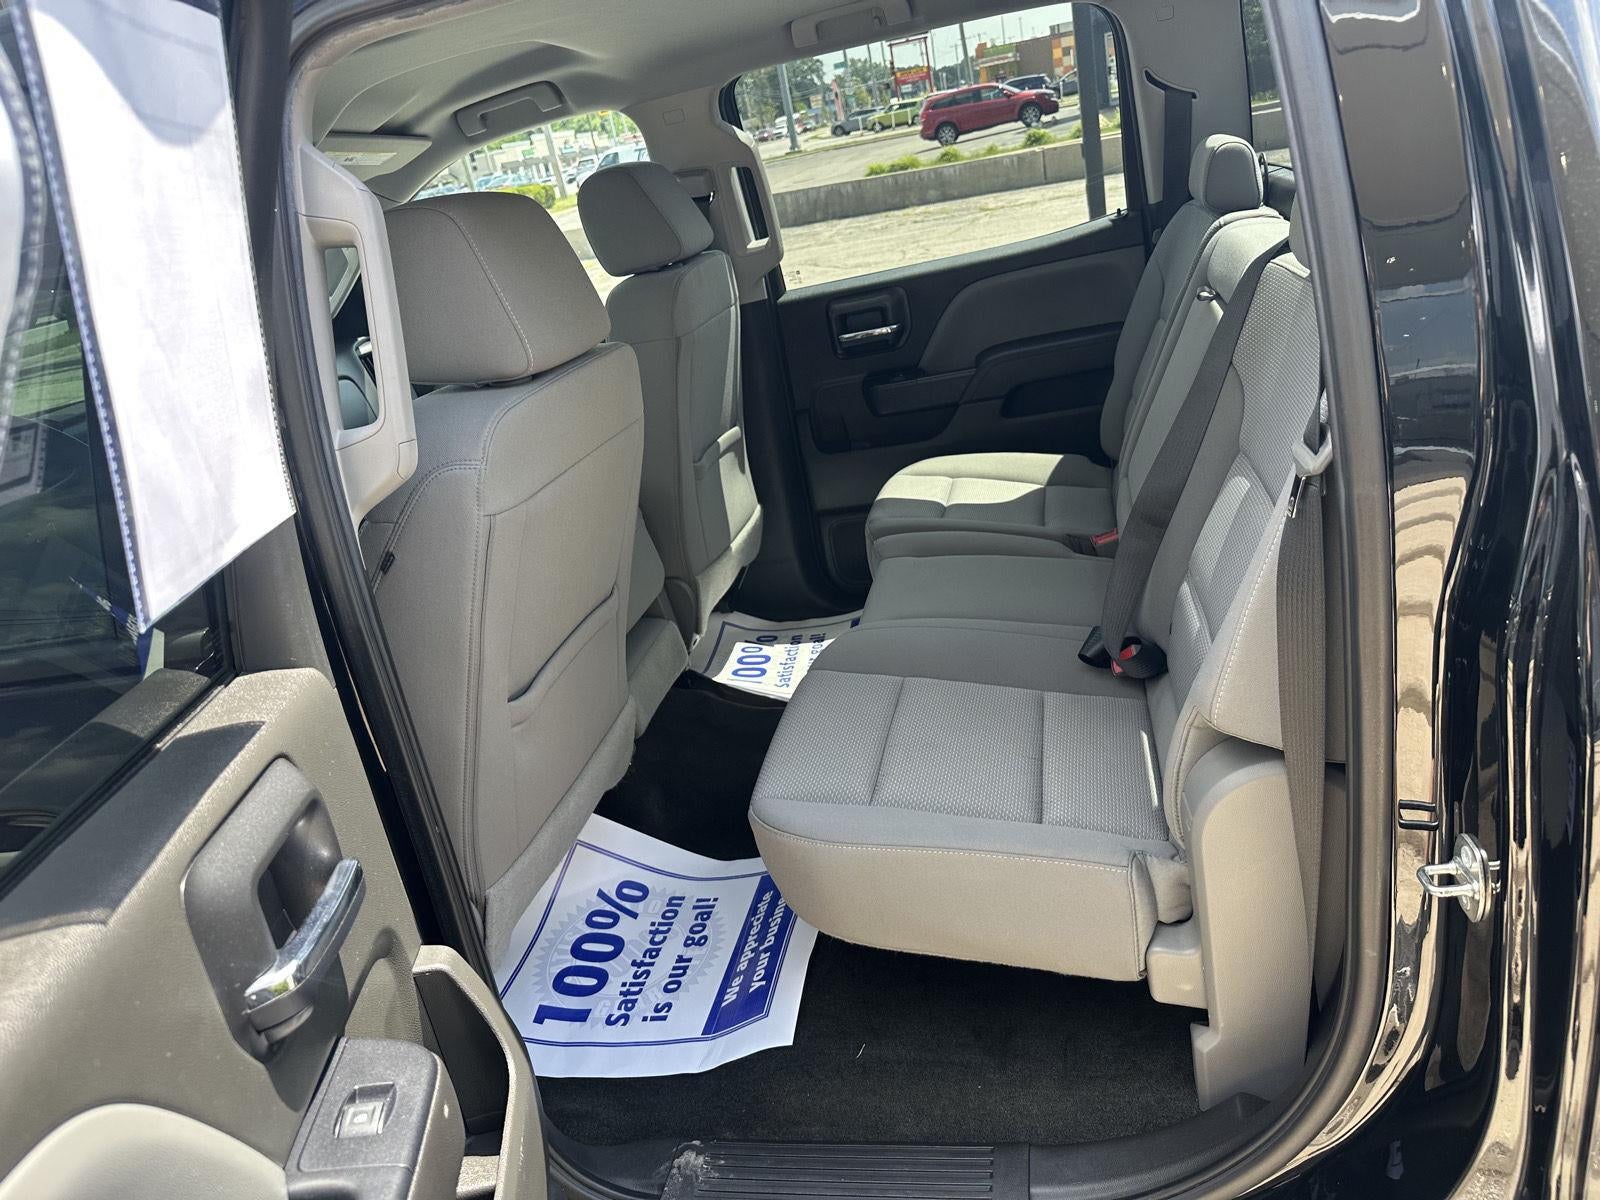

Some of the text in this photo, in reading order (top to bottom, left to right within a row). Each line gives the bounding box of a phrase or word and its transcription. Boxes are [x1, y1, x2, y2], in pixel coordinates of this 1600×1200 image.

[774, 634, 803, 688] Satisfaction
[533, 880, 650, 1025] 100%
[605, 895, 685, 1026] Satisfaction
[641, 897, 719, 1022] is our goal!
[721, 890, 774, 1008] We appreciate
[748, 951, 771, 993] your
